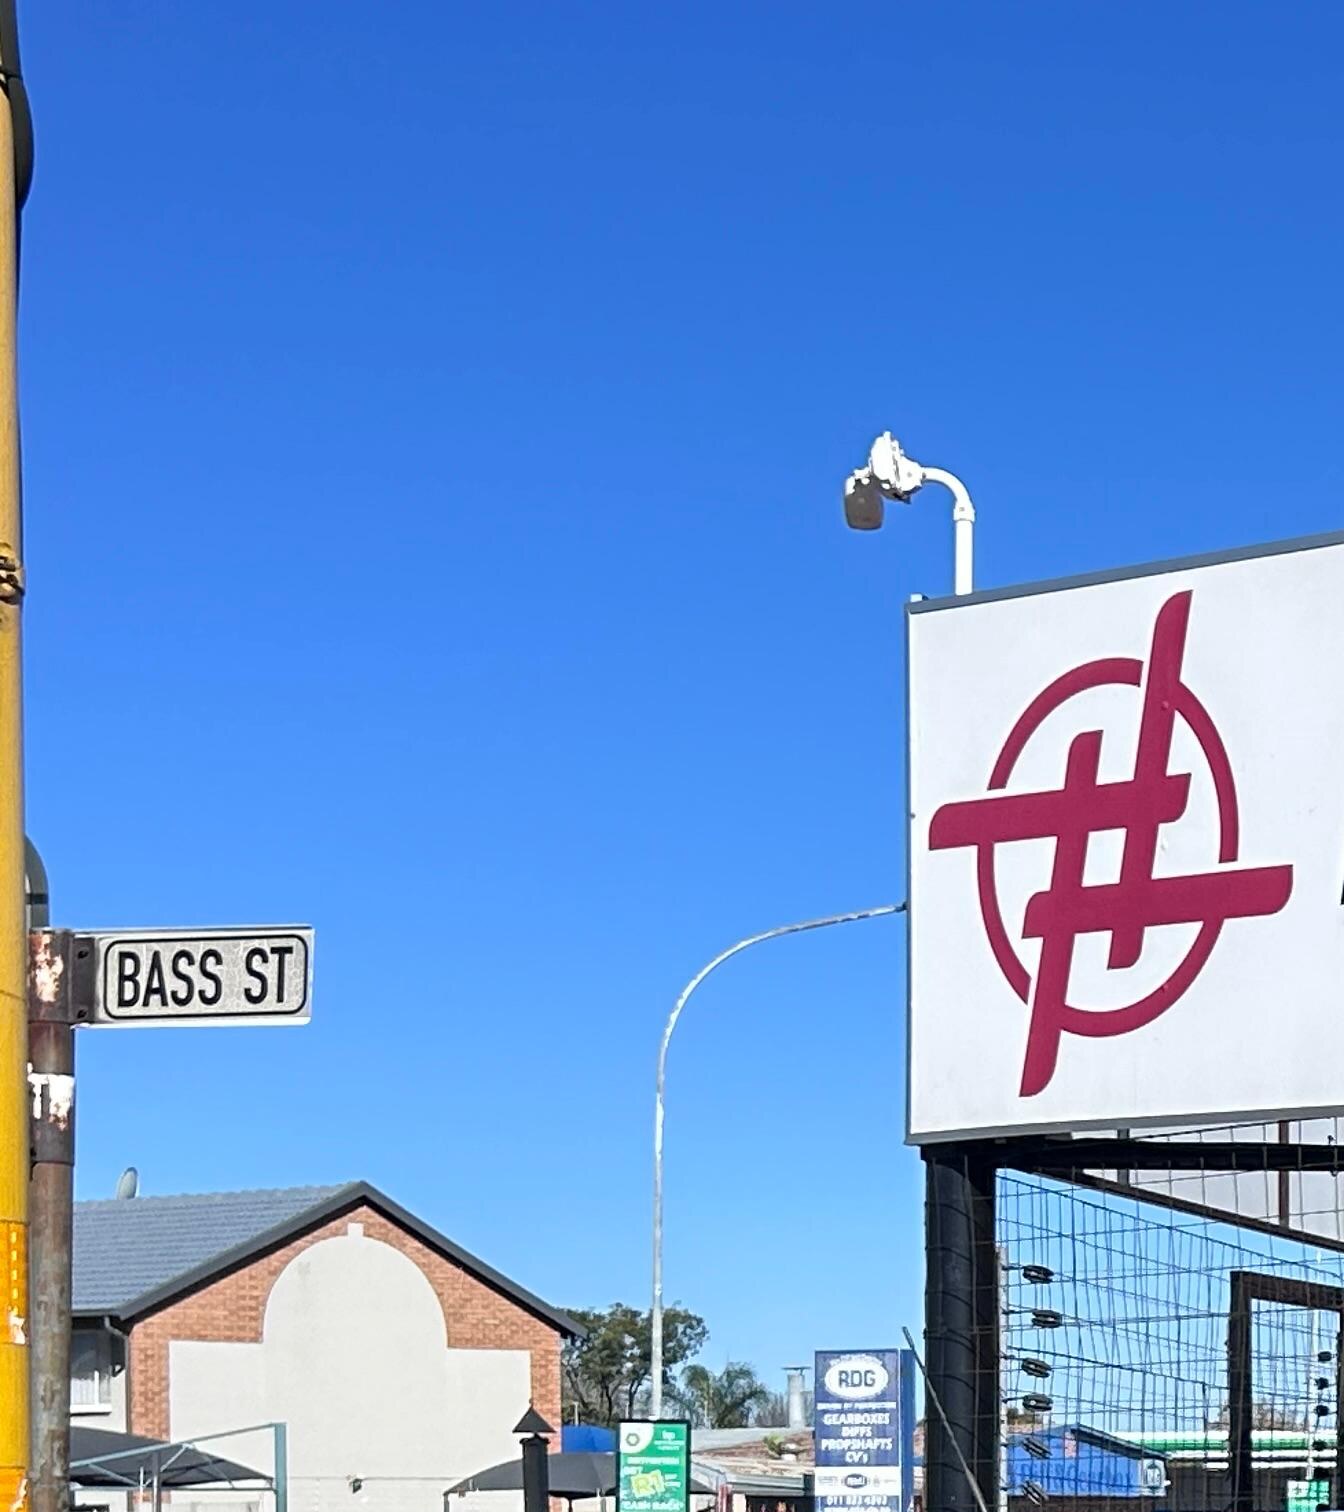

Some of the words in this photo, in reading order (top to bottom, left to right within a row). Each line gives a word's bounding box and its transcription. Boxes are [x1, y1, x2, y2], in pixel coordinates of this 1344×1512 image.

[117, 948, 223, 1008] BASS
[244, 946, 294, 1005] ST
[838, 1369, 876, 1388] RDG
